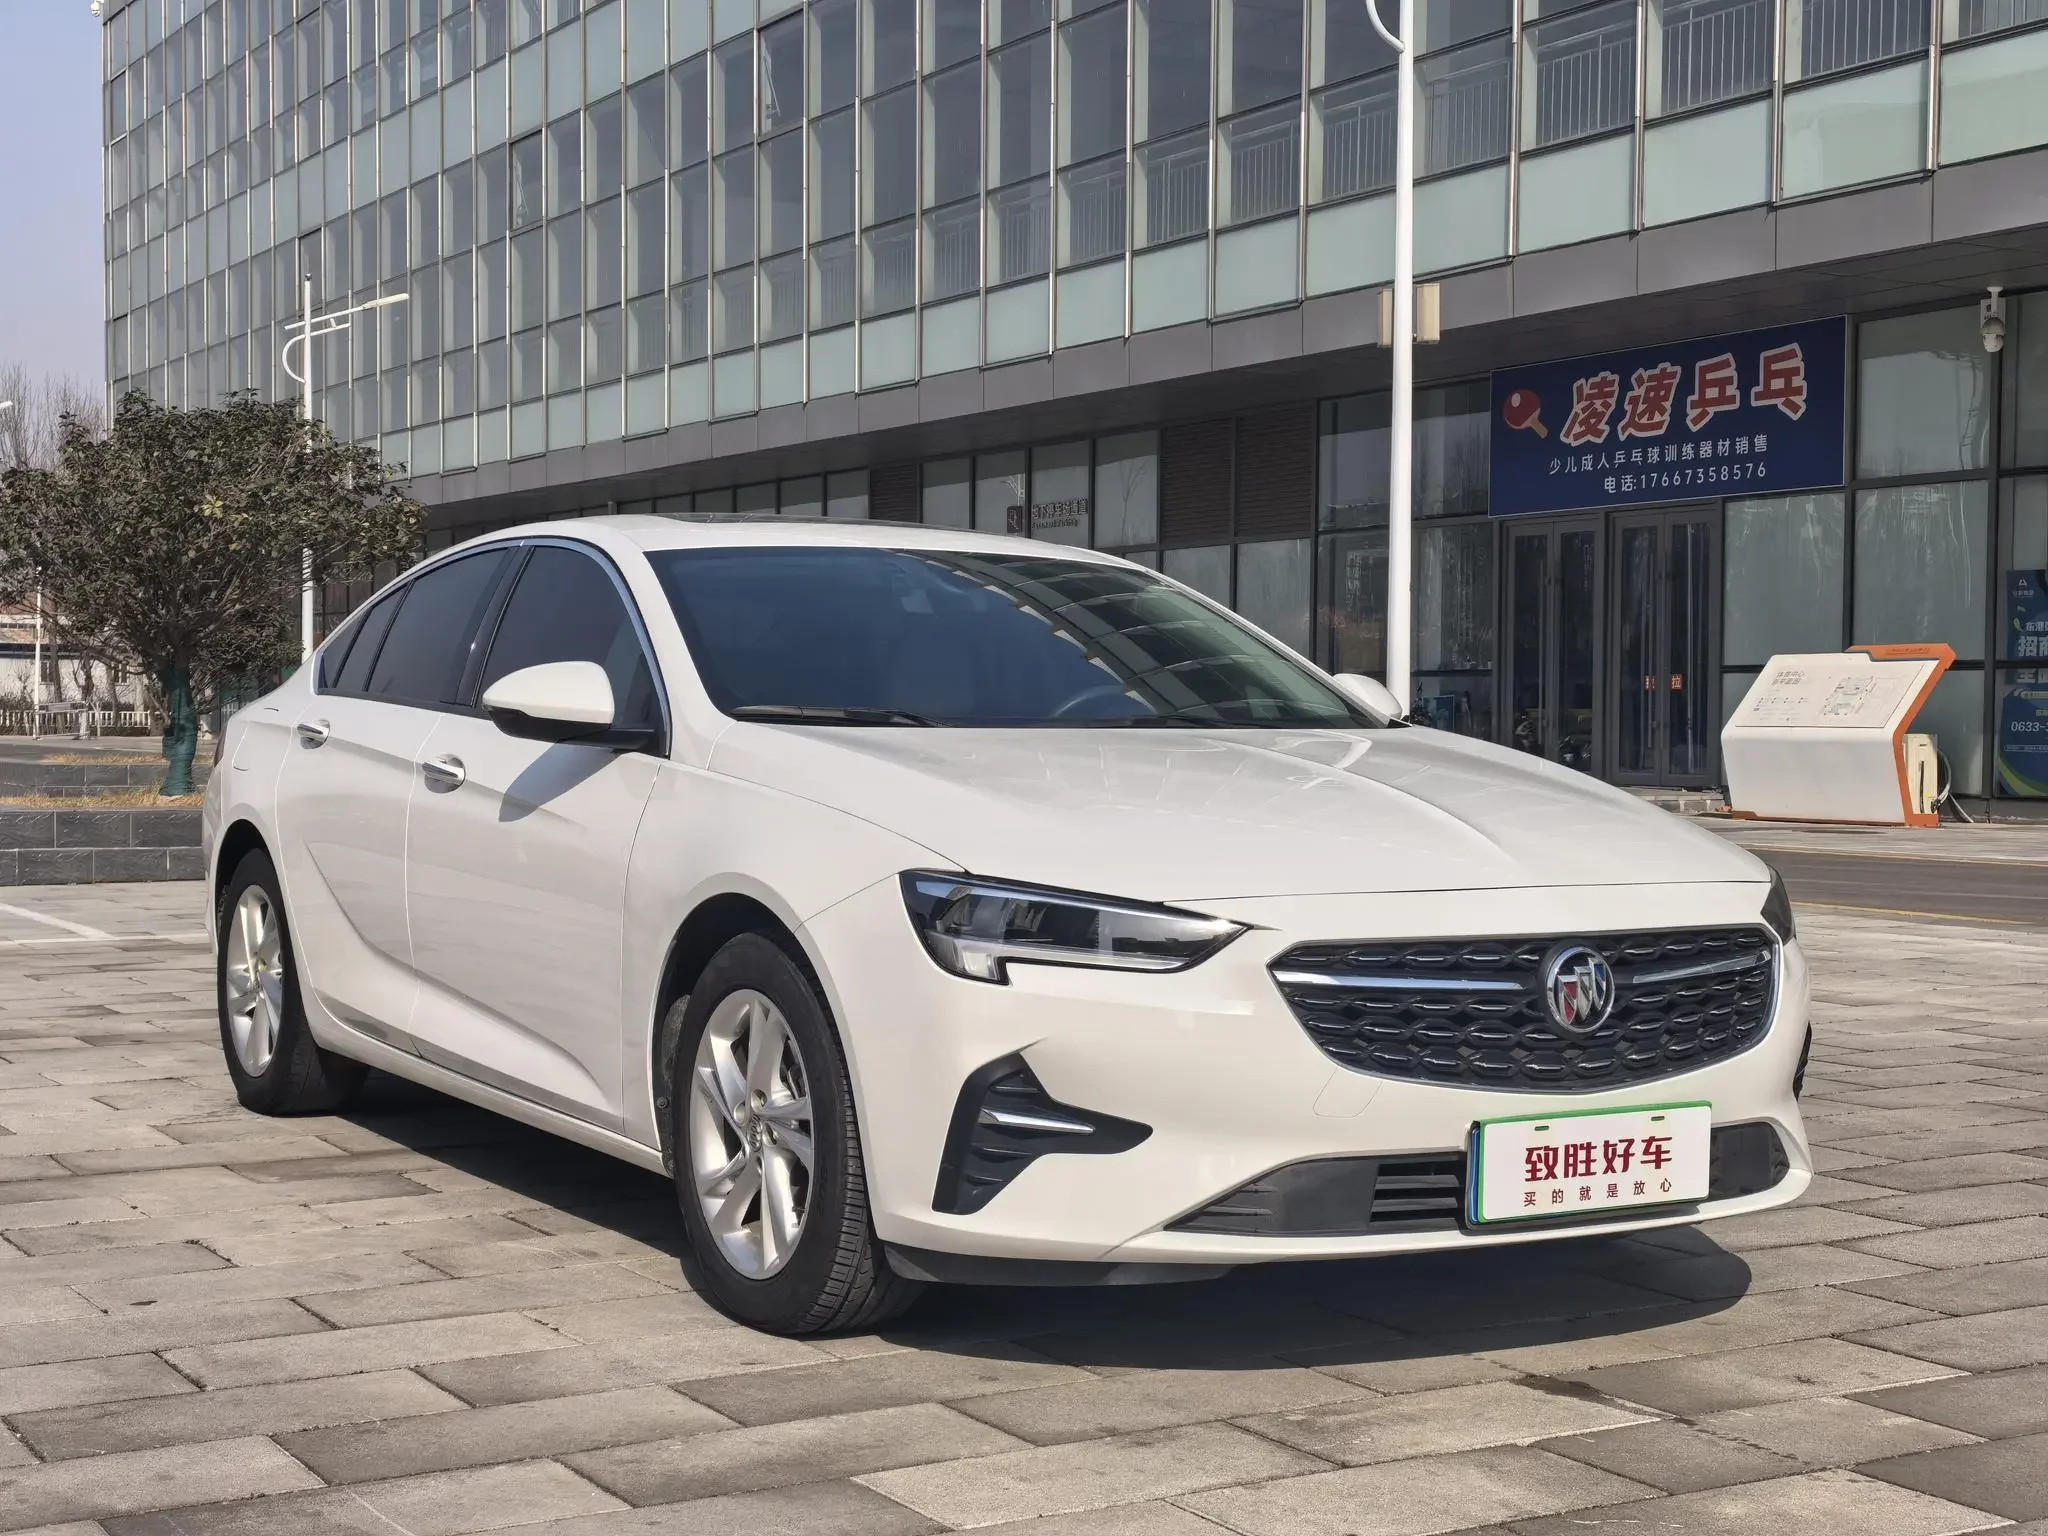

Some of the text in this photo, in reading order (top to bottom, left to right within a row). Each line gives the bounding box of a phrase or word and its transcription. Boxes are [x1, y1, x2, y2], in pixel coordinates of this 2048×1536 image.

[1560, 342, 1807, 446] 凌速乒乓
[1549, 434, 1769, 475] 少儿成人乒乓球训练器材销售
[1603, 462, 1767, 494] 电话:17667358576
[1524, 1135, 1673, 1183] 致胜好车
[1523, 1177, 1672, 1208] 买的就是放心
